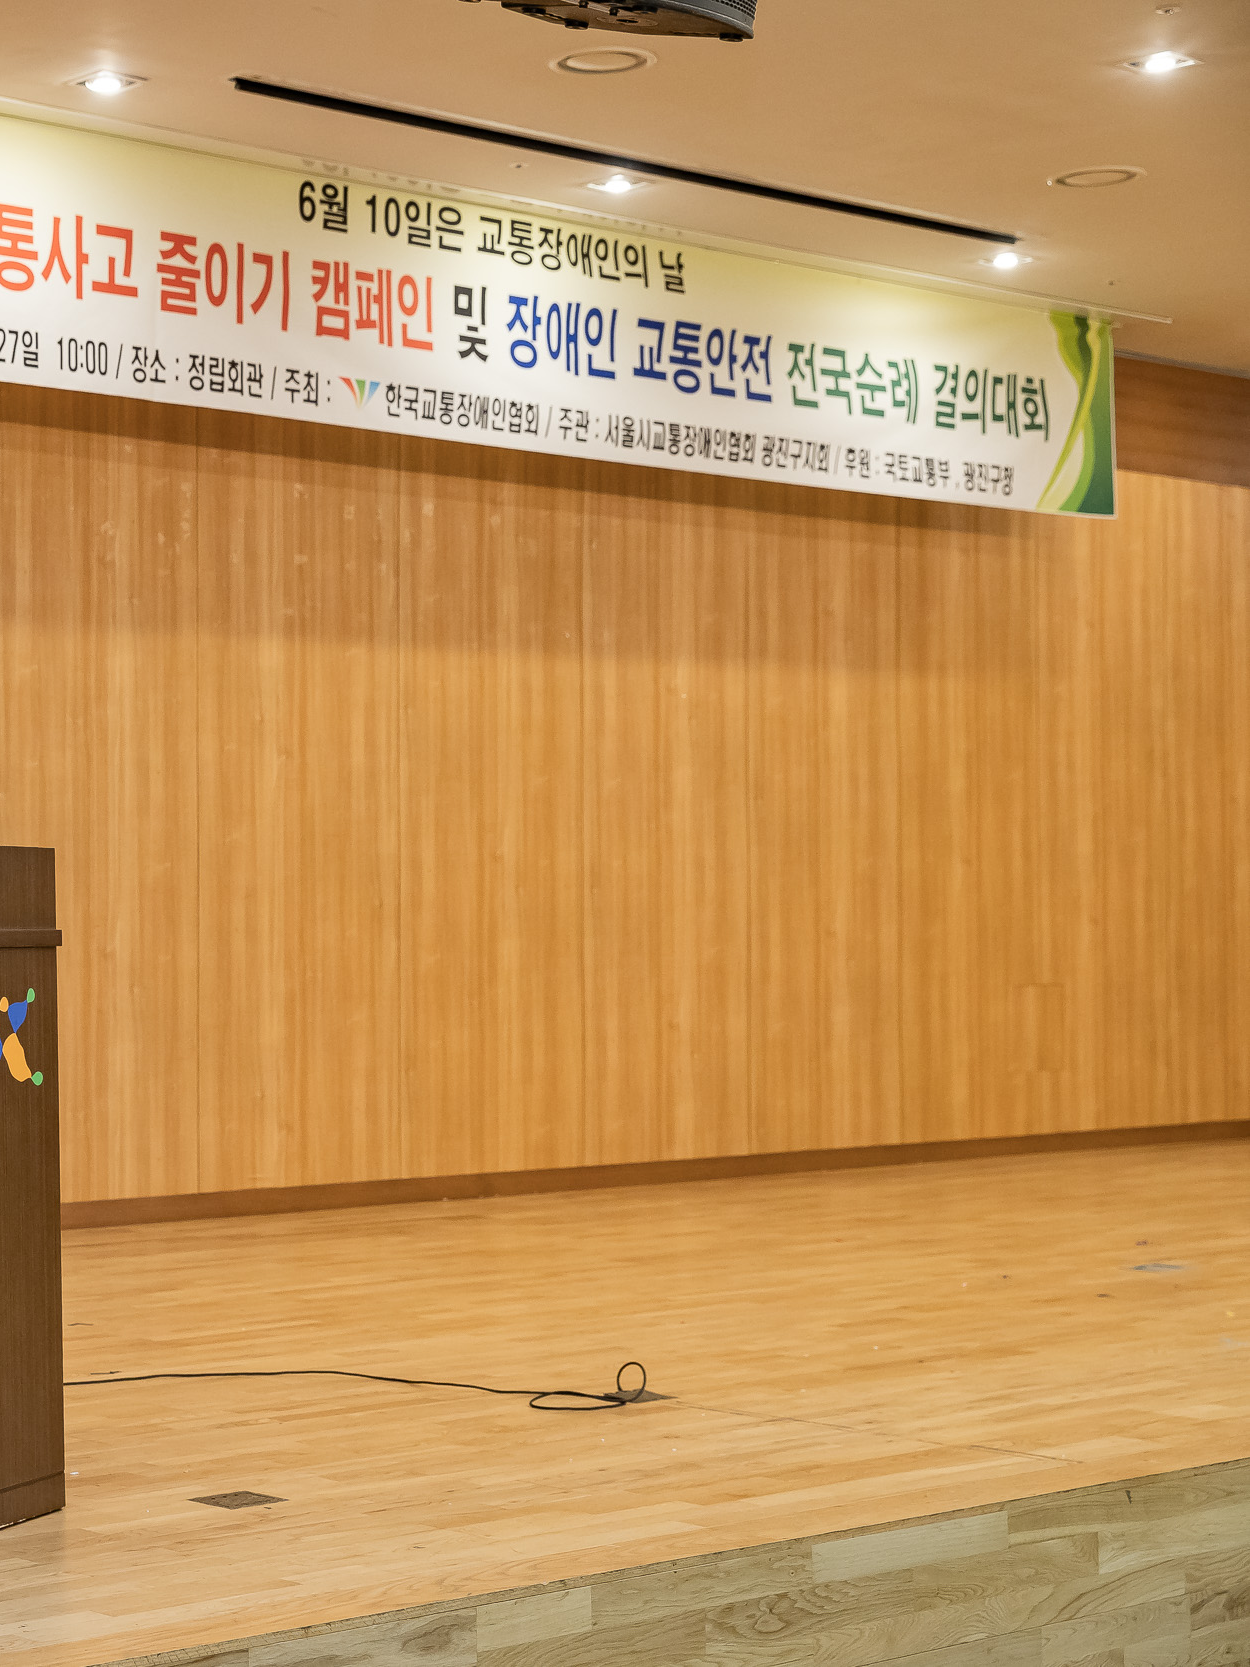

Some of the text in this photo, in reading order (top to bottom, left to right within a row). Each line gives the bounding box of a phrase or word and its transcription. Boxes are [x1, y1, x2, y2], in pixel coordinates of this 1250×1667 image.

[298, 180, 686, 294] 6월 10일은 교통장애인의 날
[157, 230, 290, 332] 줄이기
[311, 258, 434, 352] 캠페인
[453, 284, 489, 362] 및
[506, 295, 617, 380] 장애인
[633, 317, 773, 403] 교통안전
[786, 341, 918, 425] 전국순례
[933, 363, 1050, 442] 결의대회
[56, 337, 109, 375] 10:00
[131, 345, 167, 384] 장소
[188, 353, 264, 400] 정립회관
[284, 368, 320, 407] 주최
[385, 382, 540, 436] 한국교통장애인협회
[558, 407, 590, 443] 주관
[604, 413, 757, 464] 서울시교통장애인협회
[761, 434, 831, 474] 광진구지회
[845, 447, 871, 479] 후원
